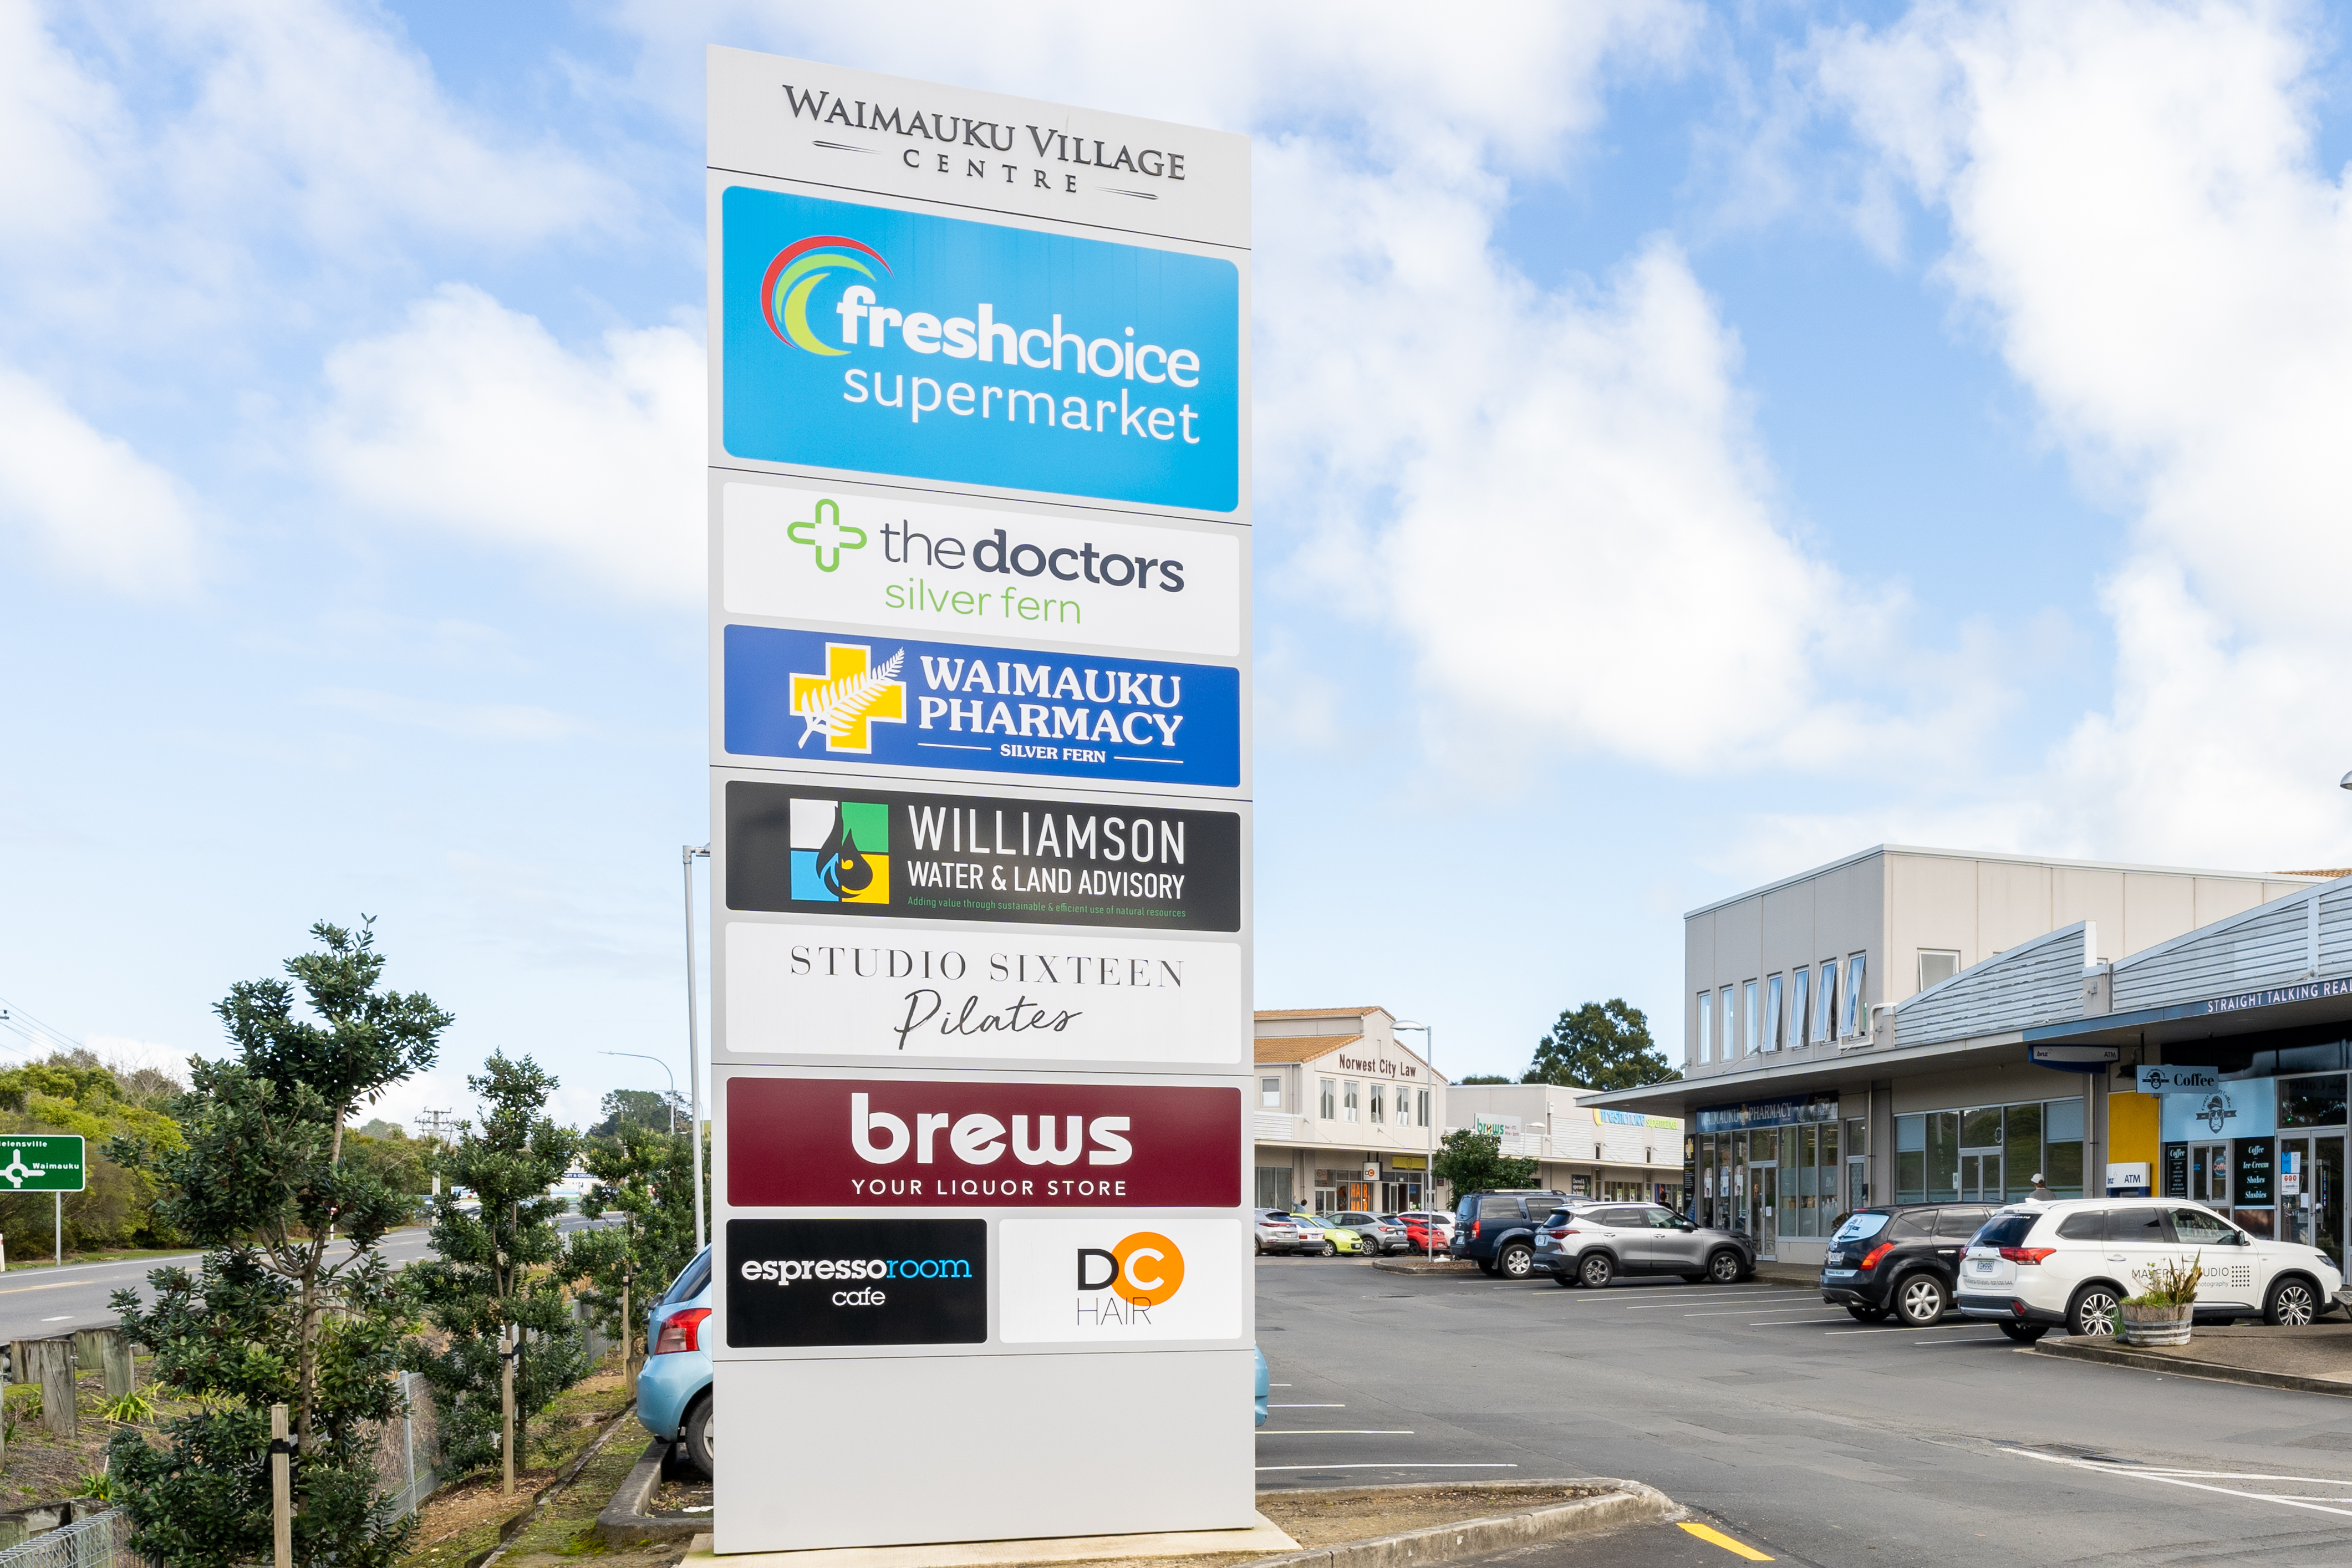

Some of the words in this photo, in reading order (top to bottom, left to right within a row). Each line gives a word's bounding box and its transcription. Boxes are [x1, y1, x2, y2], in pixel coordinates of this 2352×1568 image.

[782, 84, 1015, 151] WAIMAUKU
[1026, 125, 1185, 180] VILLAGE
[903, 149, 1077, 193] CENTRE
[836, 285, 1200, 388] freshchoice
[843, 368, 1200, 444] supermarket
[885, 578, 992, 615] silver
[1000, 586, 1081, 624] fern
[920, 655, 1181, 708] WAIMAUKU
[918, 696, 1184, 747] PHARMACY
[1000, 744, 1058, 760] SILVER
[1062, 748, 1106, 763] FERN
[907, 804, 1185, 865] WILLIAMSON
[907, 861, 984, 890] WATER
[991, 864, 1007, 892] &
[1014, 866, 1072, 894] LAND
[1078, 870, 1186, 900] ADVISORY
[908, 895, 936, 909] Adding
[939, 899, 961, 908] value
[963, 899, 996, 911] through
[998, 901, 1046, 912] sustainable
[1048, 903, 1054, 912] &
[1056, 903, 1088, 914] efficient
[1090, 906, 1104, 914] use
[1106, 905, 1114, 914] of
[1116, 906, 1145, 916] natural
[1147, 908, 1186, 918] resources
[790, 944, 966, 981] STUDIO
[989, 953, 1185, 988] SIXTEEN
[2207, 992, 2263, 1014] STRAIGHT
[2267, 984, 2318, 1004] TALKING
[893, 989, 1083, 1051] Pilates
[1339, 1053, 1376, 1073] Norwest
[1379, 1058, 1397, 1078] City
[1400, 1061, 1417, 1077] Law
[2173, 1072, 2215, 1087] Coffee
[1477, 1117, 1504, 1135] brews
[1646, 1117, 1678, 1131] supermarket
[1701, 1108, 1739, 1127] WAIMAUKU
[1748, 1102, 1793, 1122] PHARMACY
[851, 1092, 1133, 1166] brews
[2170, 1148, 2185, 1158] Coffee
[2248, 1145, 2264, 1155] Coffee
[2124, 1174, 2141, 1184] ATM
[2213, 1162, 2226, 1171] Coffe
[2247, 1175, 2266, 1184] Shakes
[851, 1179, 923, 1195] YOUR
[937, 1179, 1034, 1196] LIQUOR
[1047, 1180, 1127, 1196] STORE
[741, 1259, 973, 1286] espressoroom
[1077, 1247, 1165, 1291] DC
[2131, 1268, 2187, 1279] MAERCK
[2191, 1267, 2229, 1277] UDIO
[832, 1287, 886, 1306] cafe
[1077, 1297, 1152, 1326] HAIR
